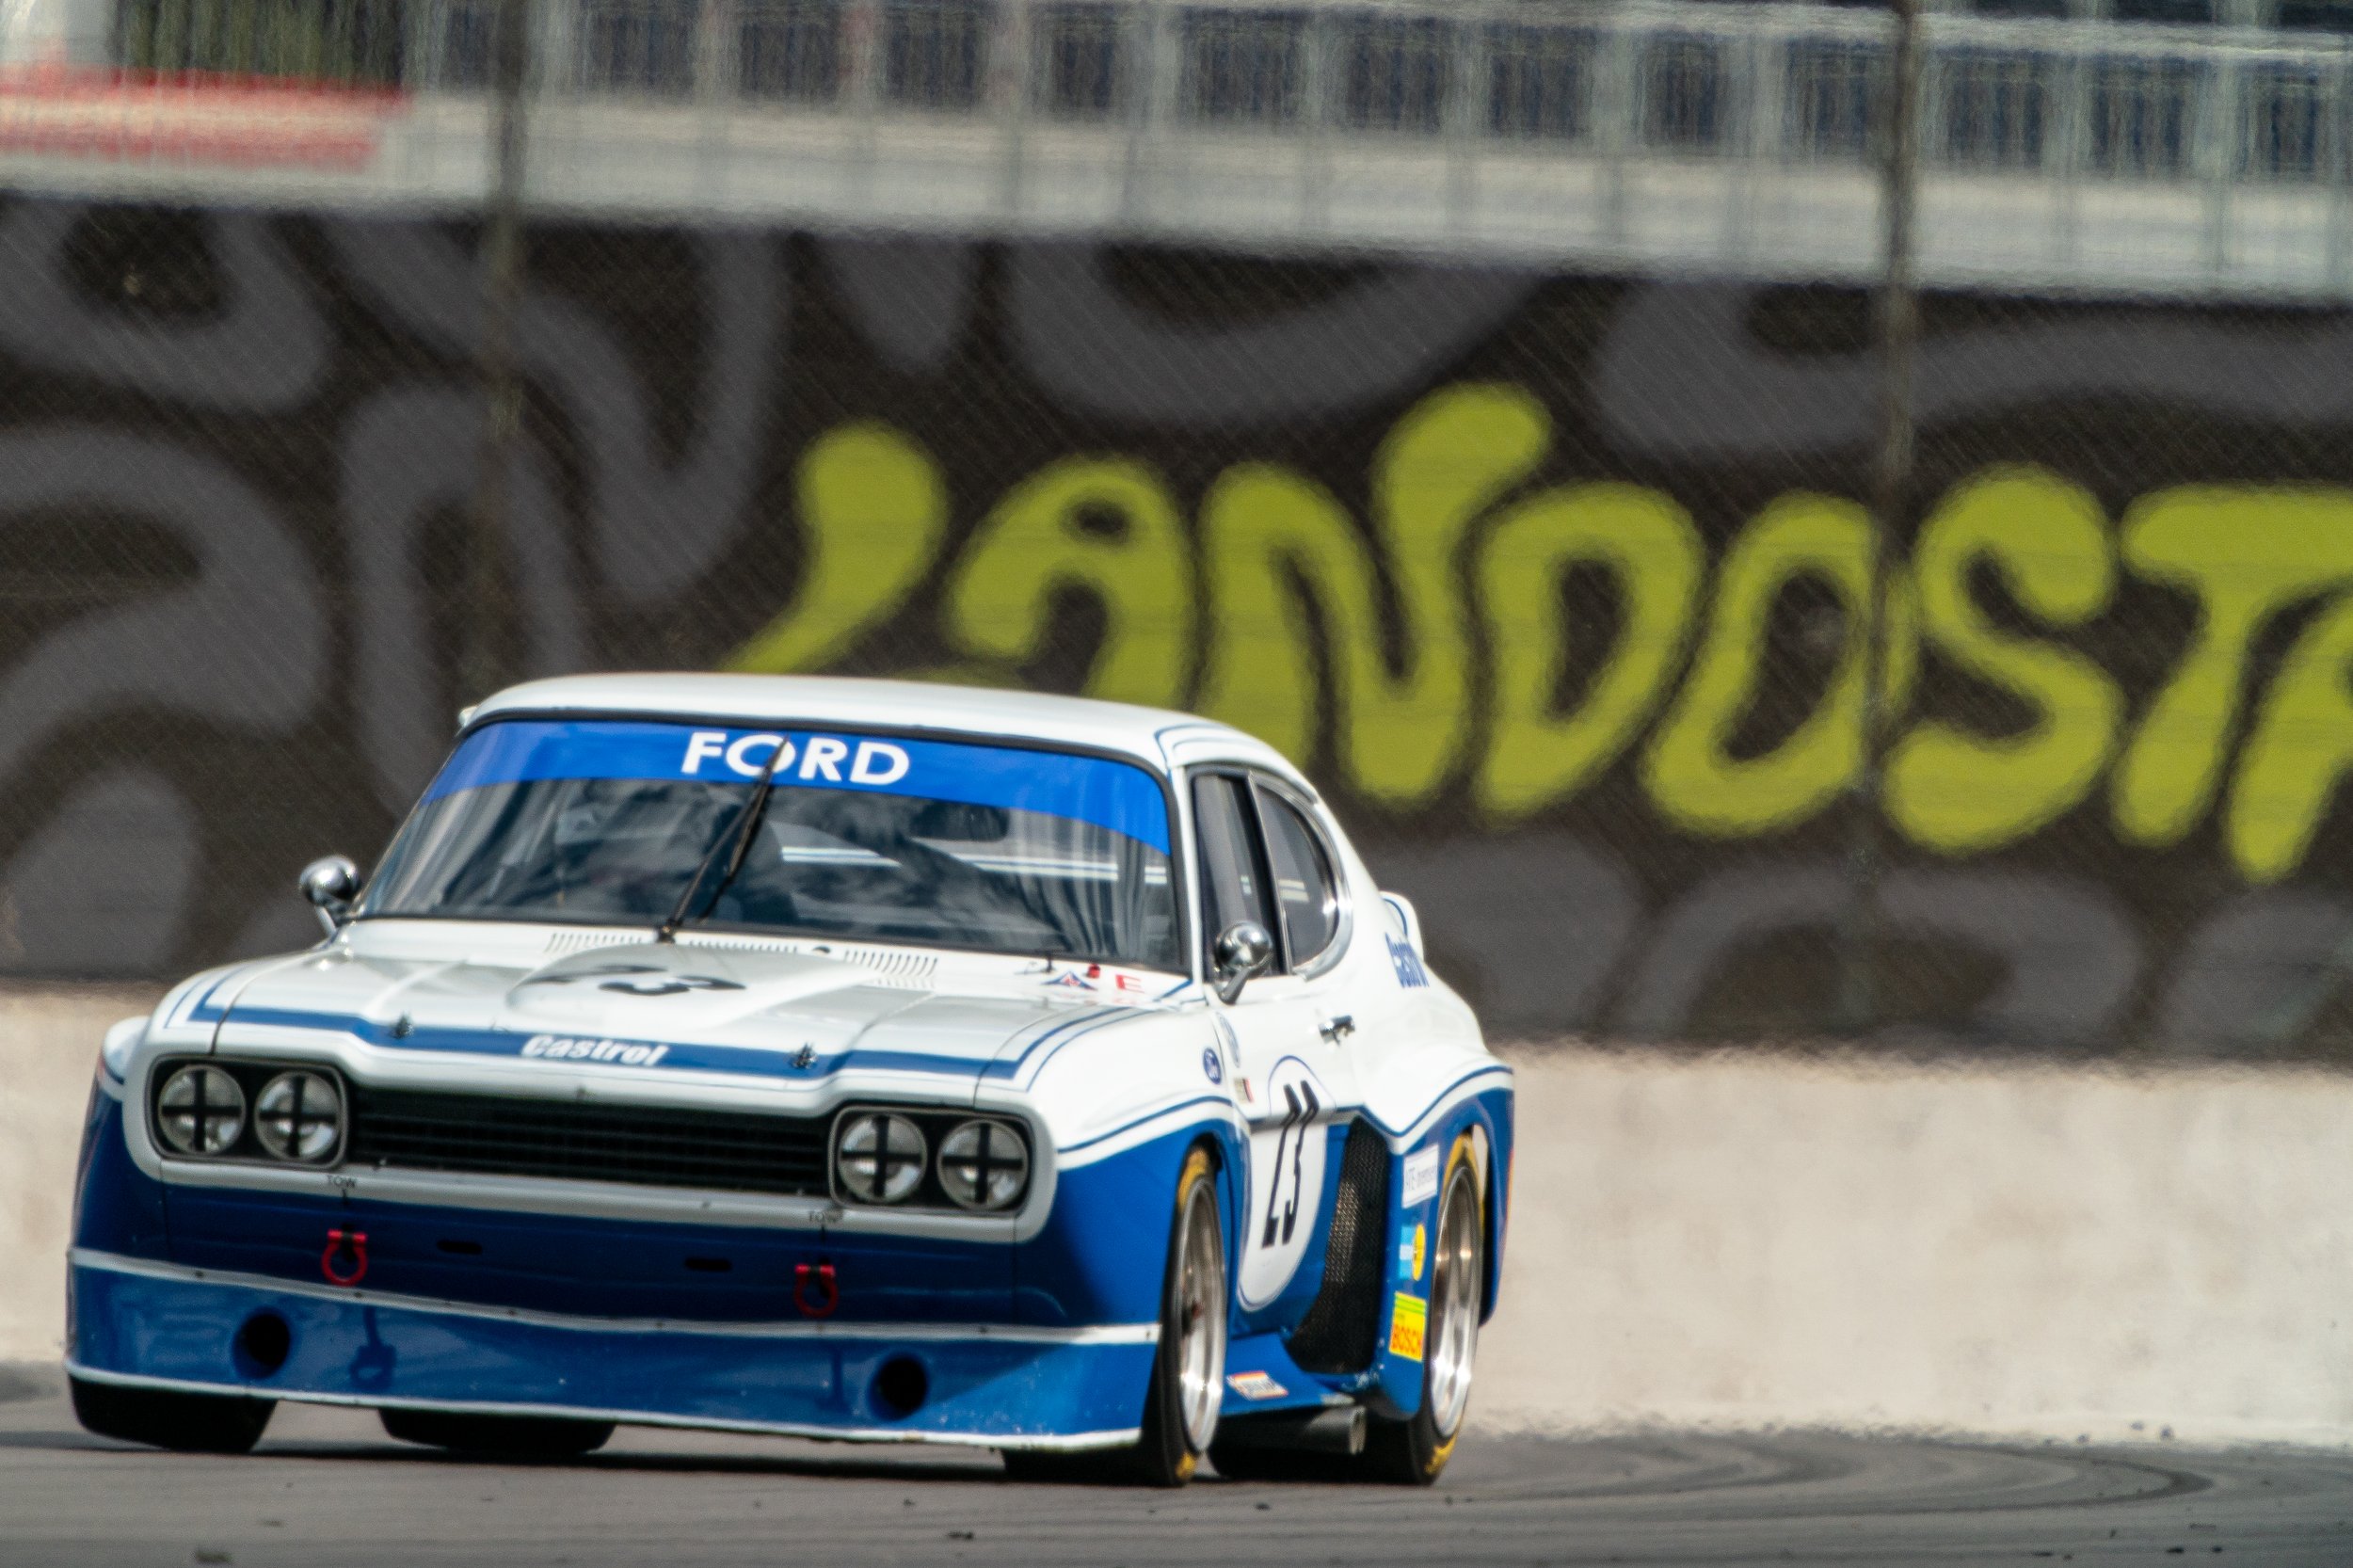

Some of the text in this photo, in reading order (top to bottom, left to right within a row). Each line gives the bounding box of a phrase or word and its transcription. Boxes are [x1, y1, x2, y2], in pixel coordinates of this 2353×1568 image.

[680, 731, 910, 785] FORD
[521, 1033, 670, 1067] Castrol
[327, 1174, 357, 1189] TOW
[1261, 1080, 1320, 1249] 23
[1390, 1322, 1423, 1360] BOSCH
